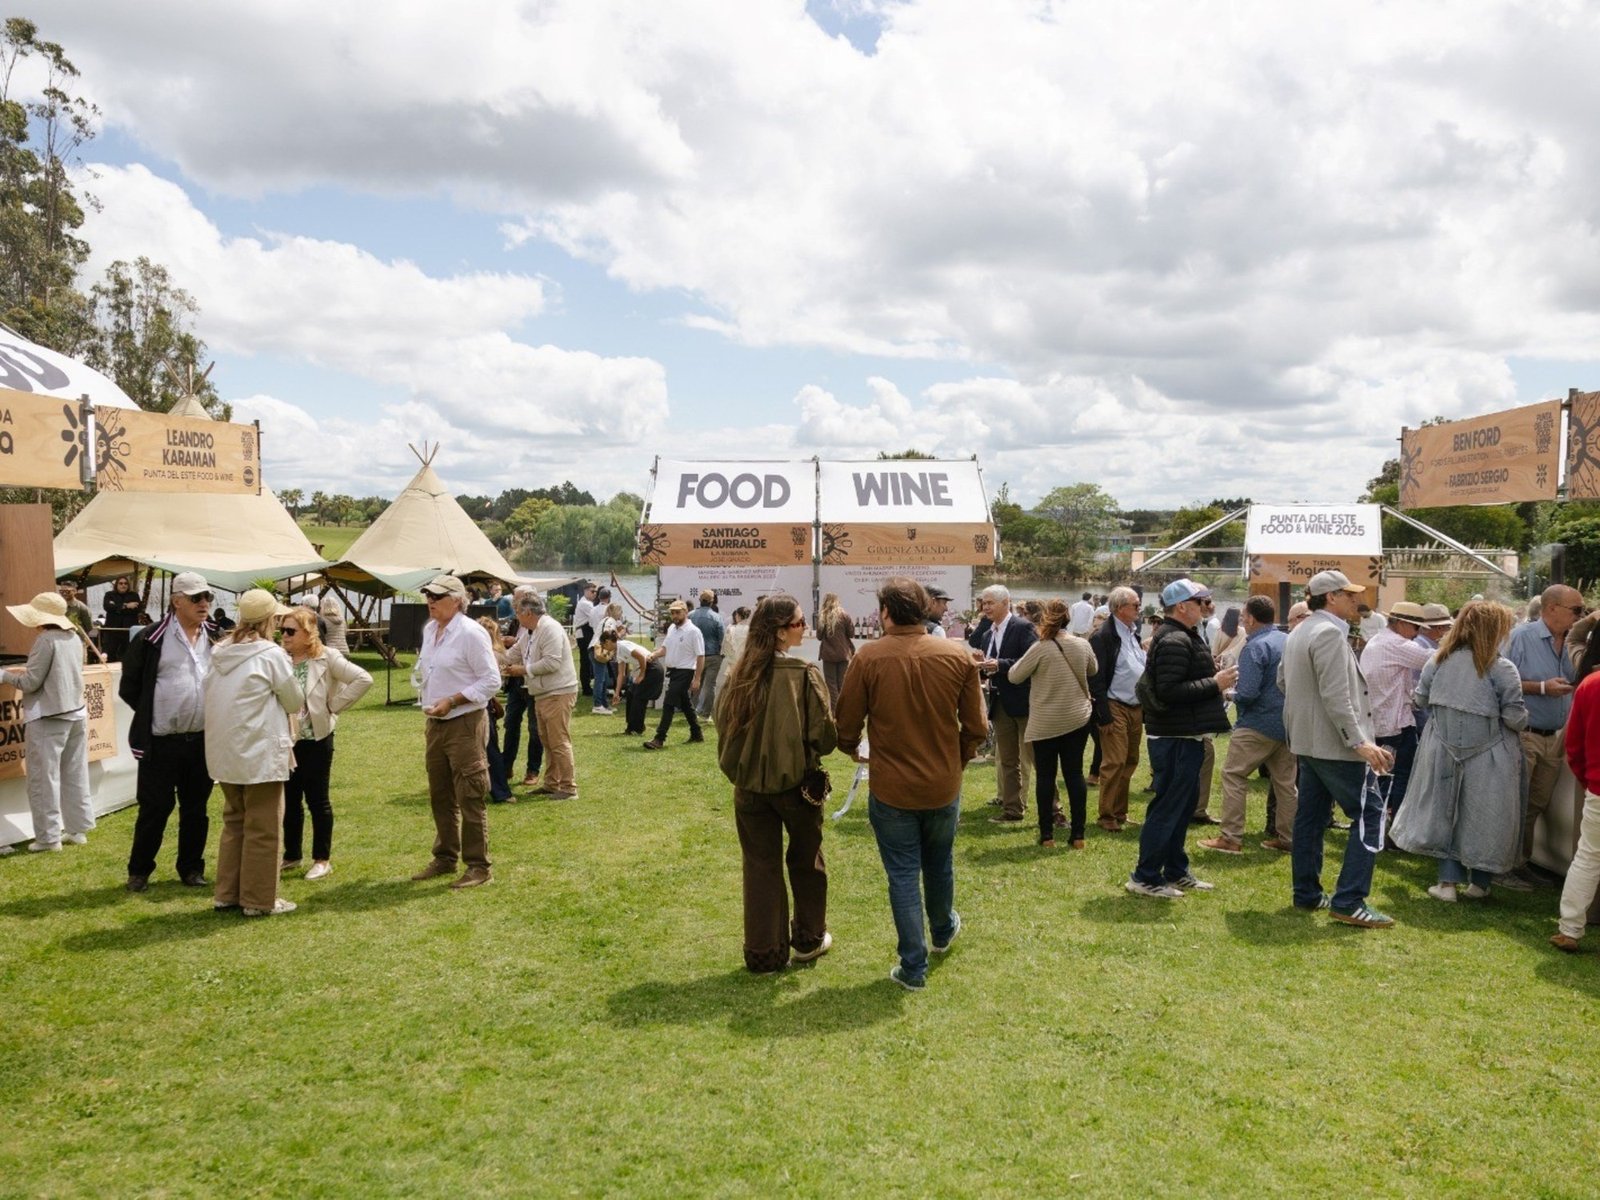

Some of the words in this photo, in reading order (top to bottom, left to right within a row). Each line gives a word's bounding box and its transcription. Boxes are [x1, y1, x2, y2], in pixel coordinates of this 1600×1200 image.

[166, 429, 214, 449] LEANDRO
[1453, 431, 1472, 452] BEN
[1473, 426, 1501, 449] FORD
[162, 449, 216, 468] KARAMAN
[143, 469, 166, 478] PUNTA
[167, 470, 179, 479] DEL
[181, 471, 196, 480] ESTE
[1480, 467, 1509, 485] SERGIO
[676, 472, 791, 509] FOOD
[852, 472, 953, 507] WINE
[1270, 514, 1307, 525] PUNTA
[1309, 514, 1330, 524] DEL
[1331, 514, 1357, 525] ESTE
[702, 528, 760, 538] SANTIAGO
[1260, 524, 1294, 535] FOOD
[1295, 524, 1302, 534] &
[1304, 524, 1333, 535] WINE
[1334, 524, 1366, 537] 2025
[693, 539, 767, 549] INZAURRALDE
[90, 742, 112, 752] AUSTRAL
